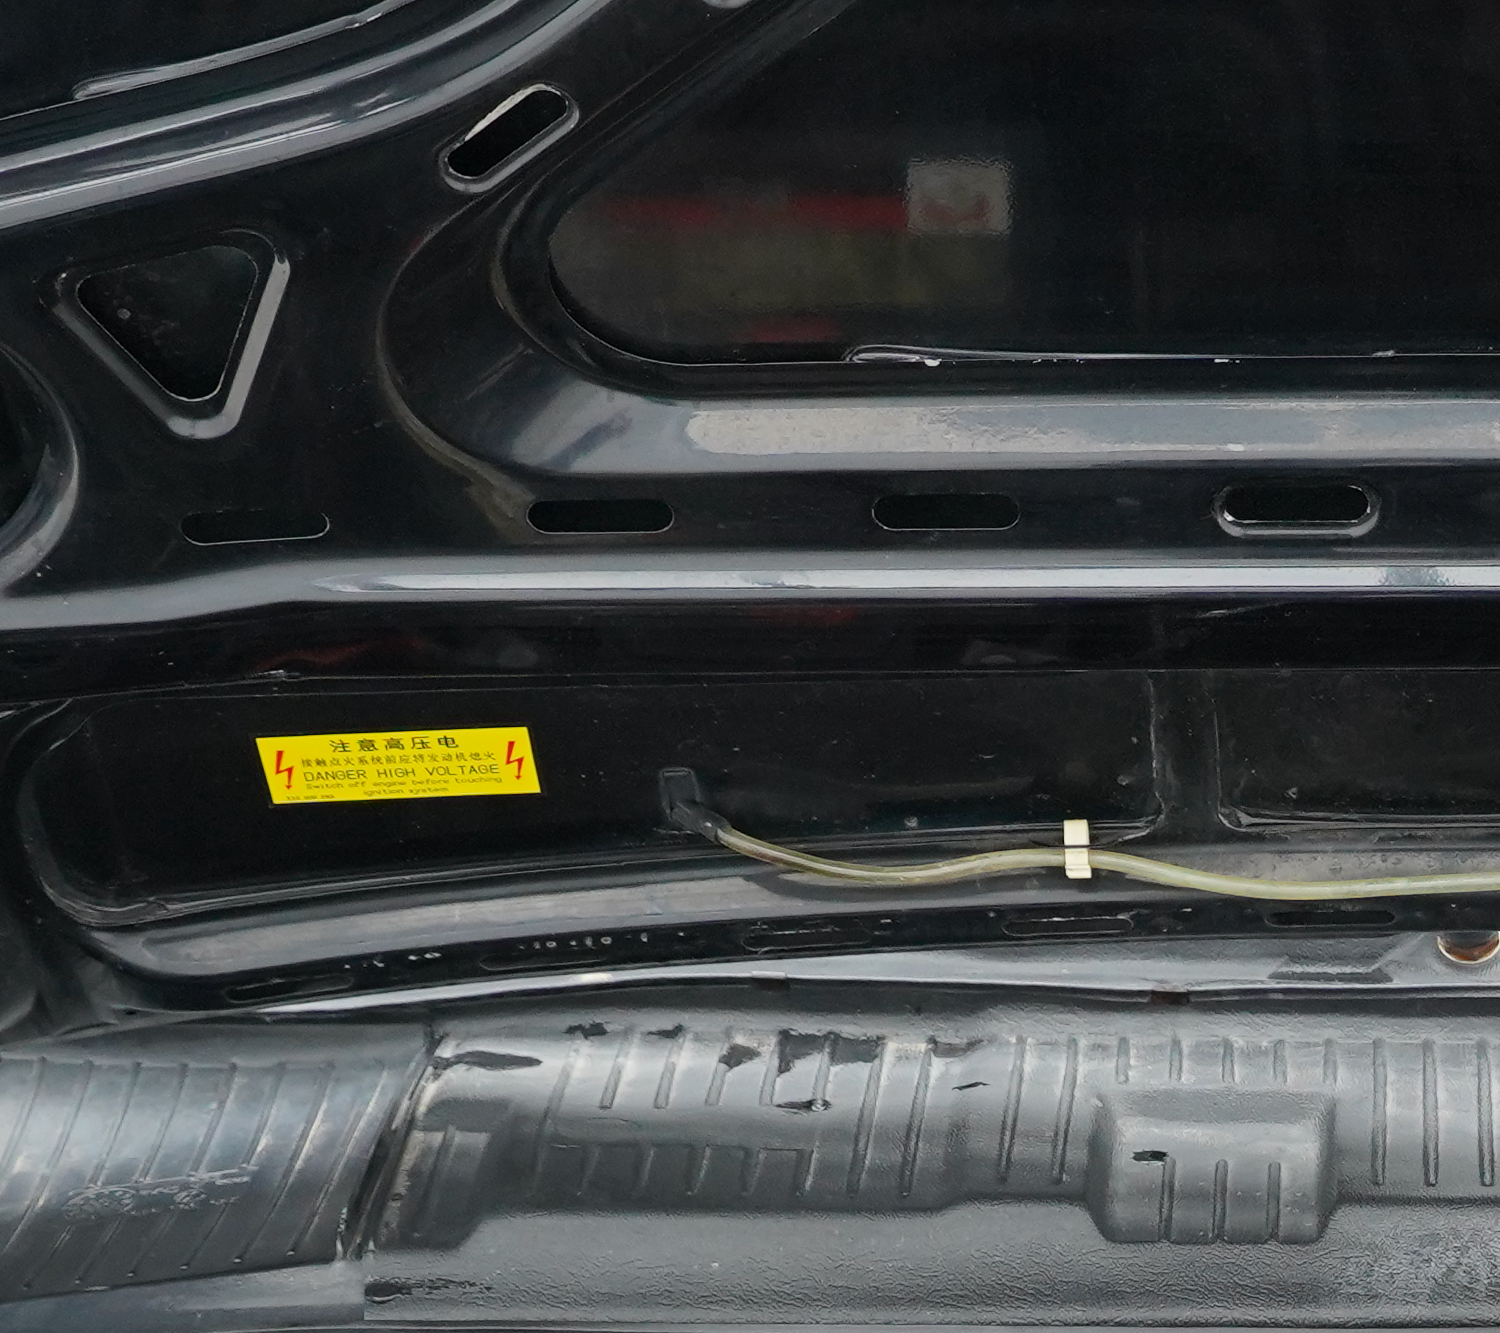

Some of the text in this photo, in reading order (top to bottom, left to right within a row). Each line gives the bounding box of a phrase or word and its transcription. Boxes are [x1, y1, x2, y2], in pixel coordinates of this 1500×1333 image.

[328, 735, 460, 753] 注意高压电
[303, 764, 501, 782] DANGER HIGH VOLTAGE
[306, 775, 503, 790] Switch off engine before touching
[363, 786, 450, 797] ignition system
